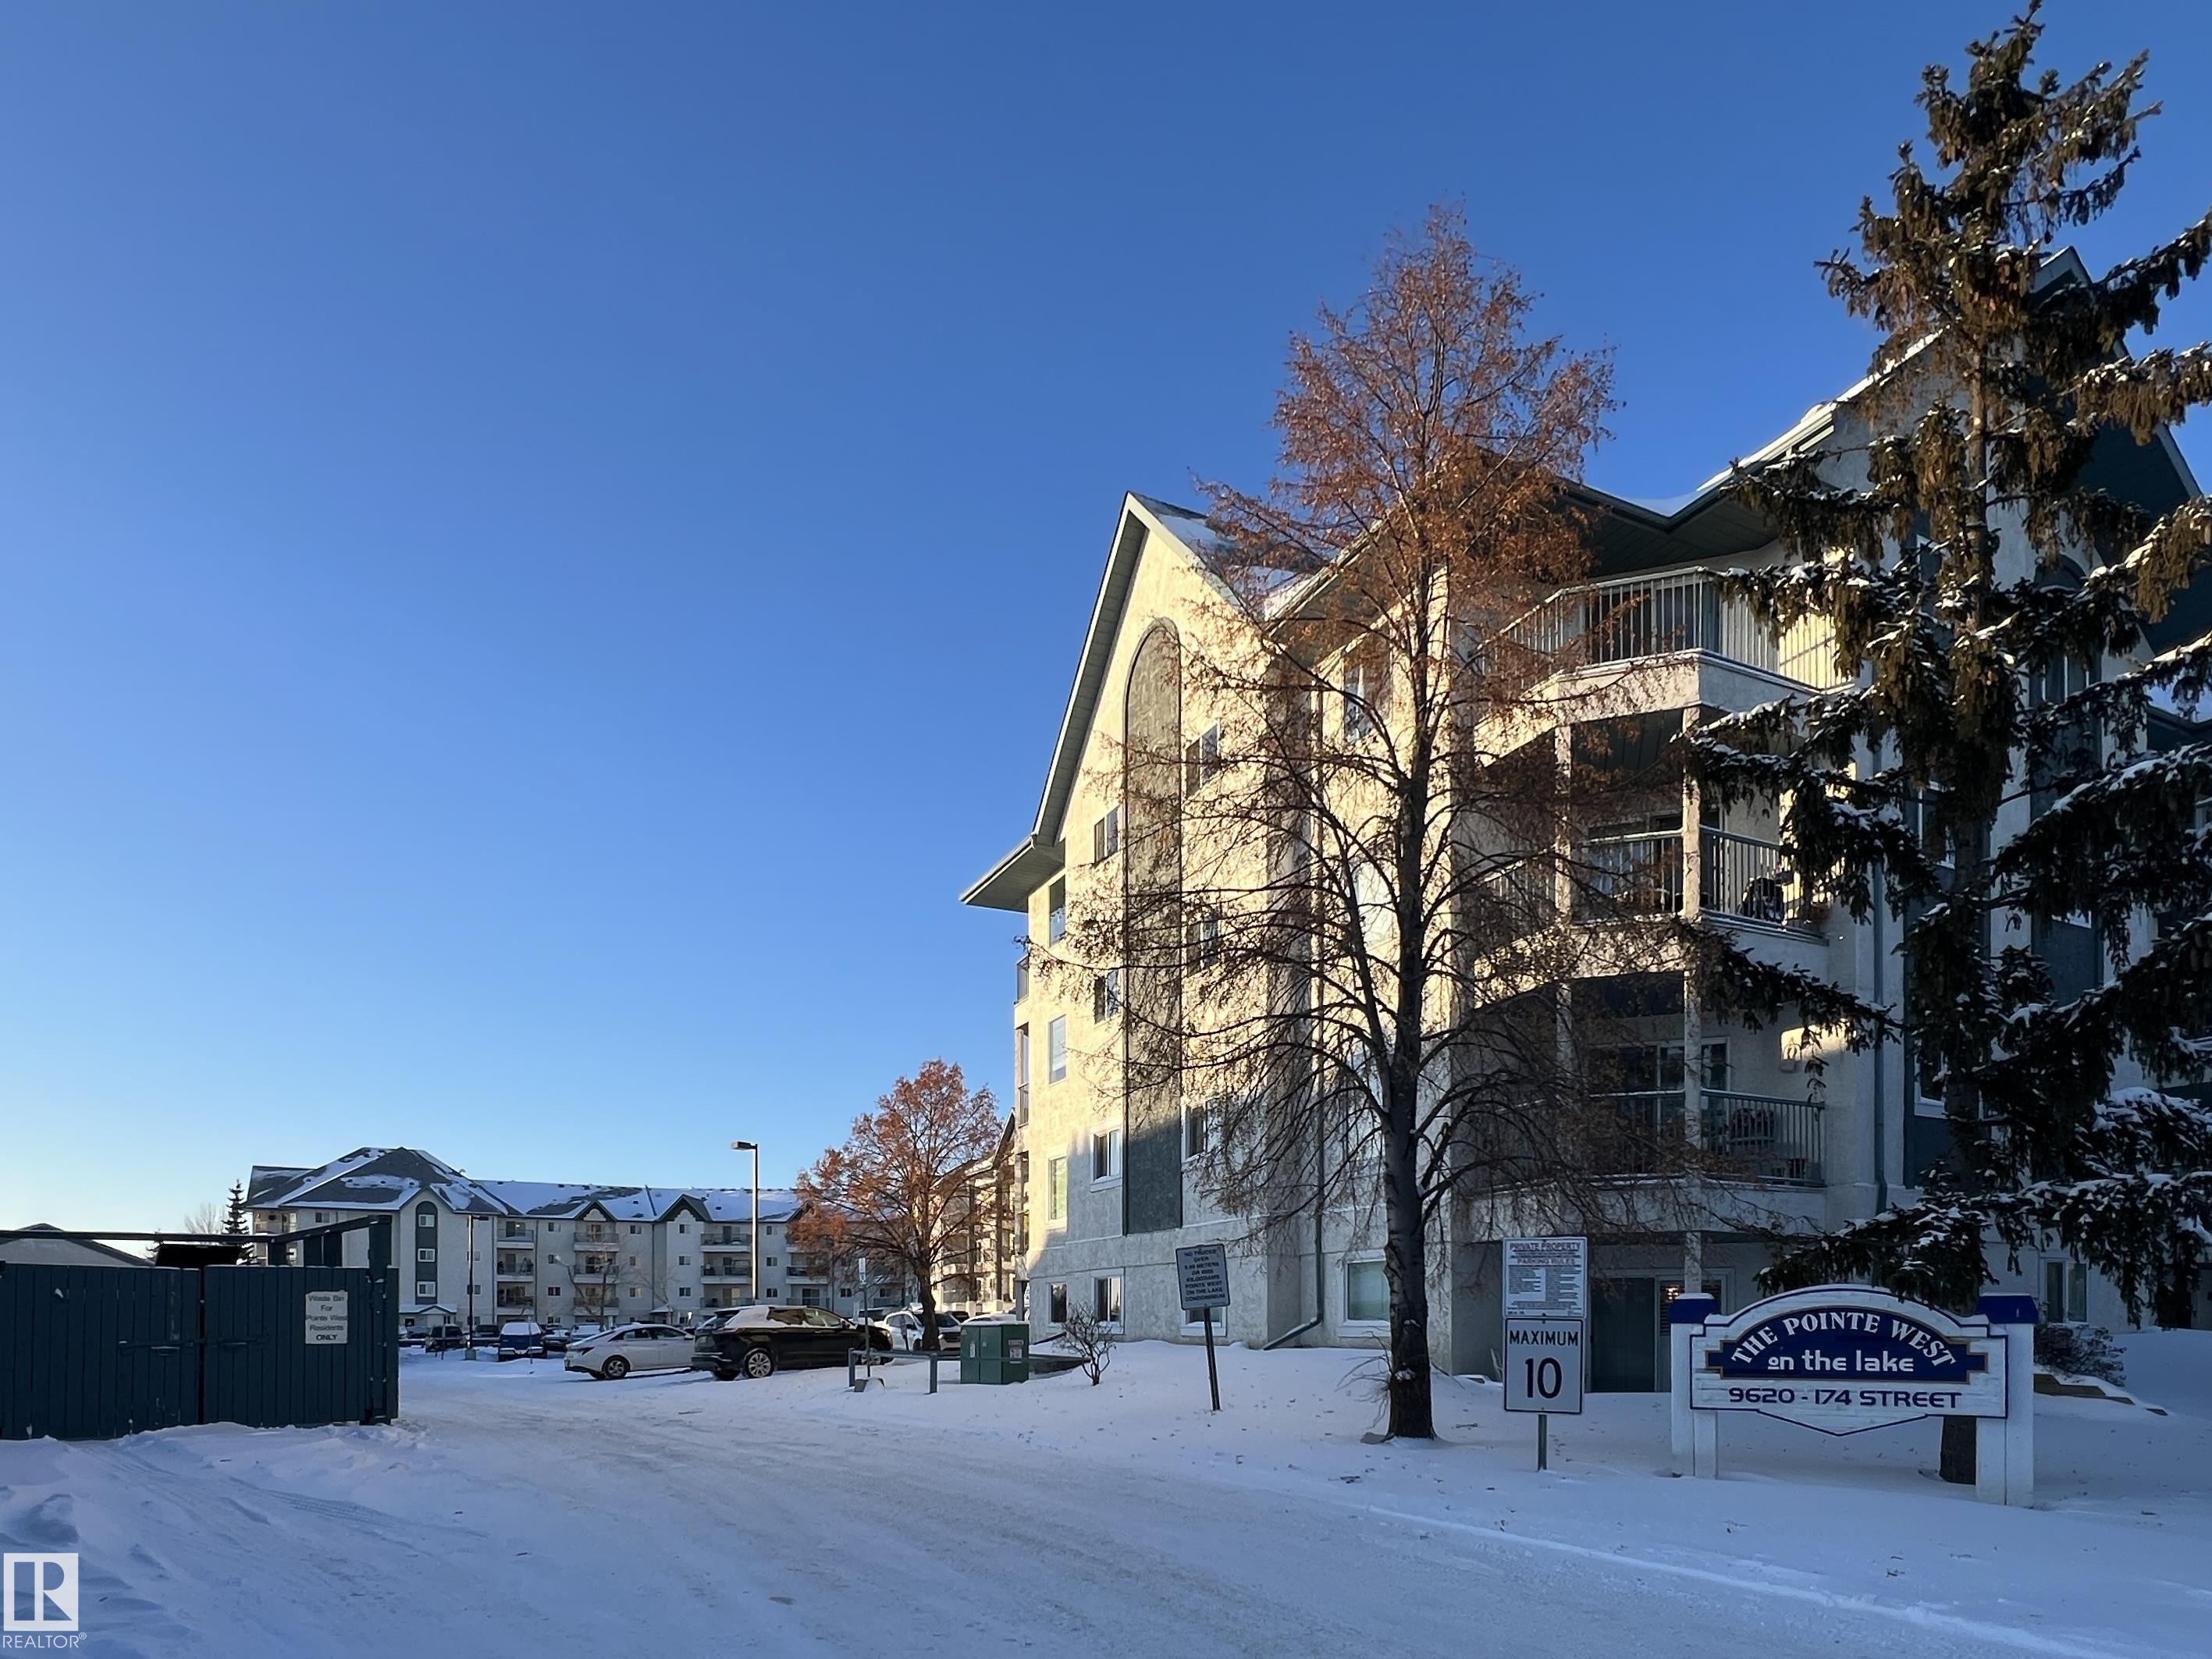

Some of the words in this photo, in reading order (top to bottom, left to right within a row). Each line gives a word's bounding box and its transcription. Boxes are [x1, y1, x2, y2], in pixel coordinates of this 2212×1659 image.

[1541, 1242, 1581, 1250] PROPERTY
[1509, 1330, 1578, 1346] MAXIMUM
[1730, 1326, 1778, 1363] THE
[1782, 1312, 1880, 1335] POINTE
[1891, 1320, 1956, 1366] WEST
[1767, 1356, 1794, 1370] on
[1801, 1349, 1847, 1371] the
[1856, 1350, 1914, 1372] lake
[1525, 1357, 1562, 1398] 10
[1728, 1387, 1795, 1403] 9620
[1815, 1389, 1852, 1405] 174
[1859, 1391, 1962, 1409] STREET
